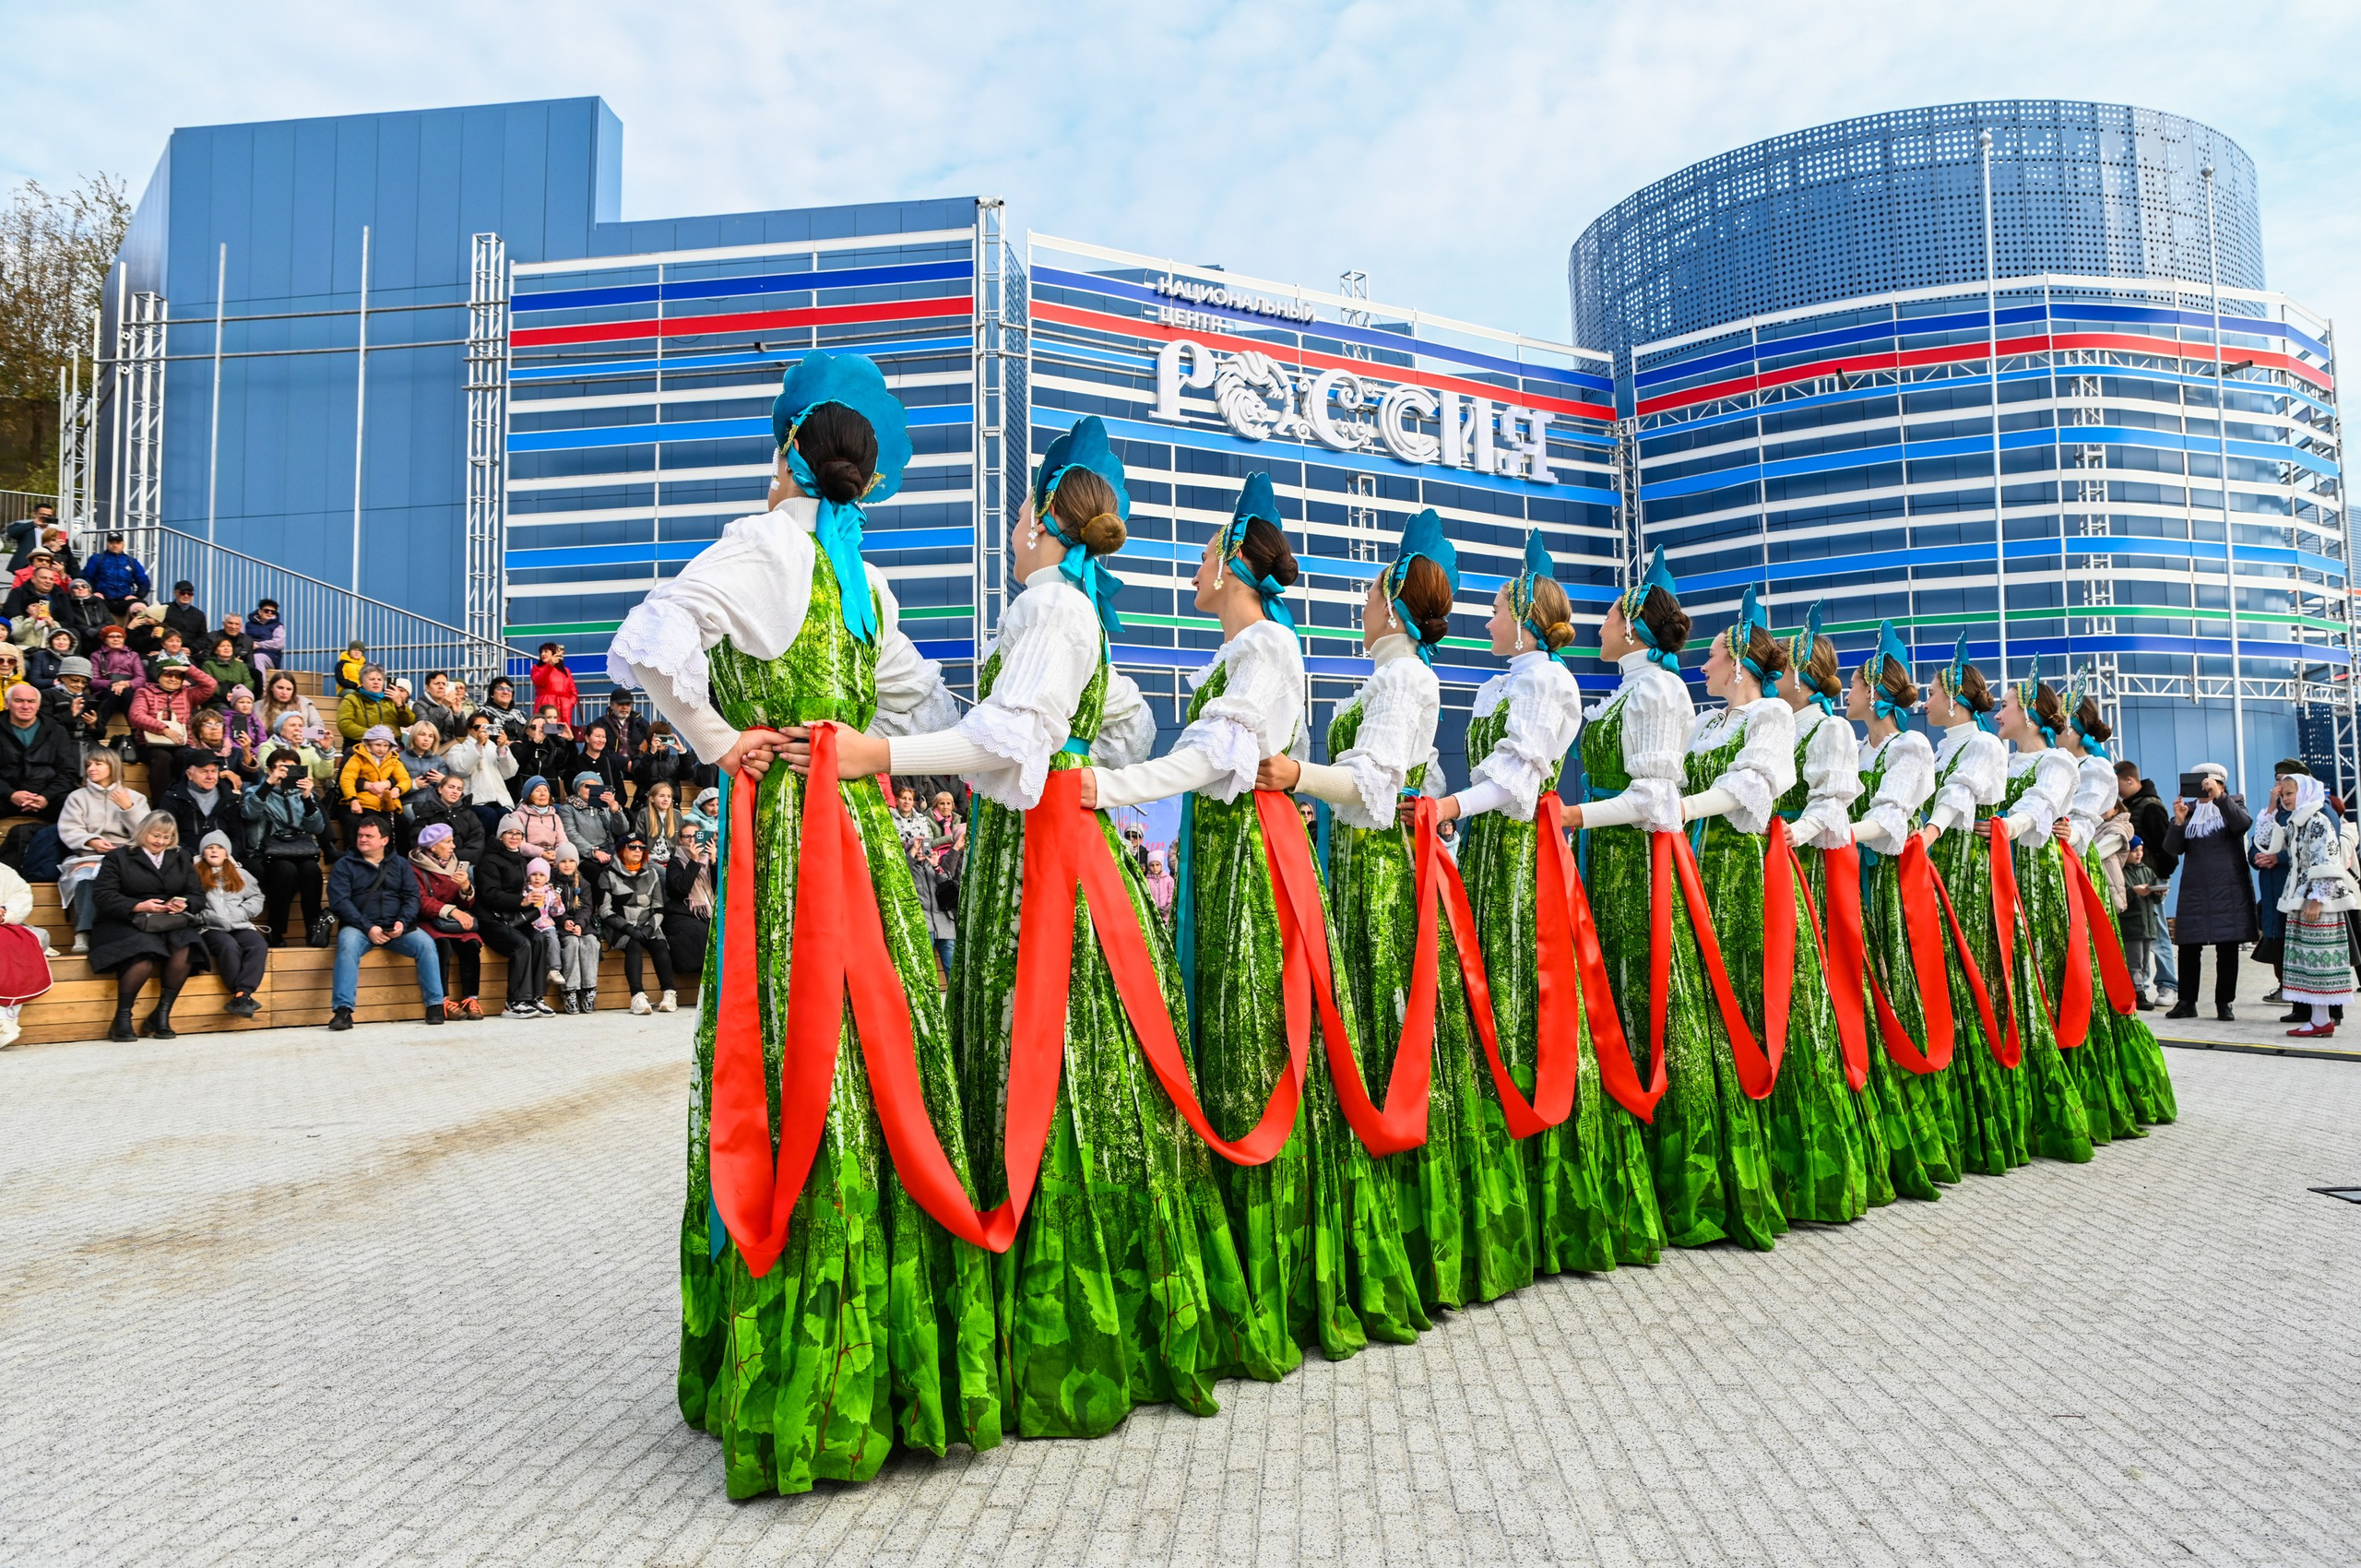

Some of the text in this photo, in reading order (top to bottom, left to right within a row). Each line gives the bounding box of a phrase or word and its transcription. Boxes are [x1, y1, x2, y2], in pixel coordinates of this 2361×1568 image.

[1157, 276, 1316, 323] НАЦИОНАЛЬНЫЙ
[1158, 305, 1222, 333] ЦЕНТР
[1148, 339, 1559, 484] РОССИЯ
